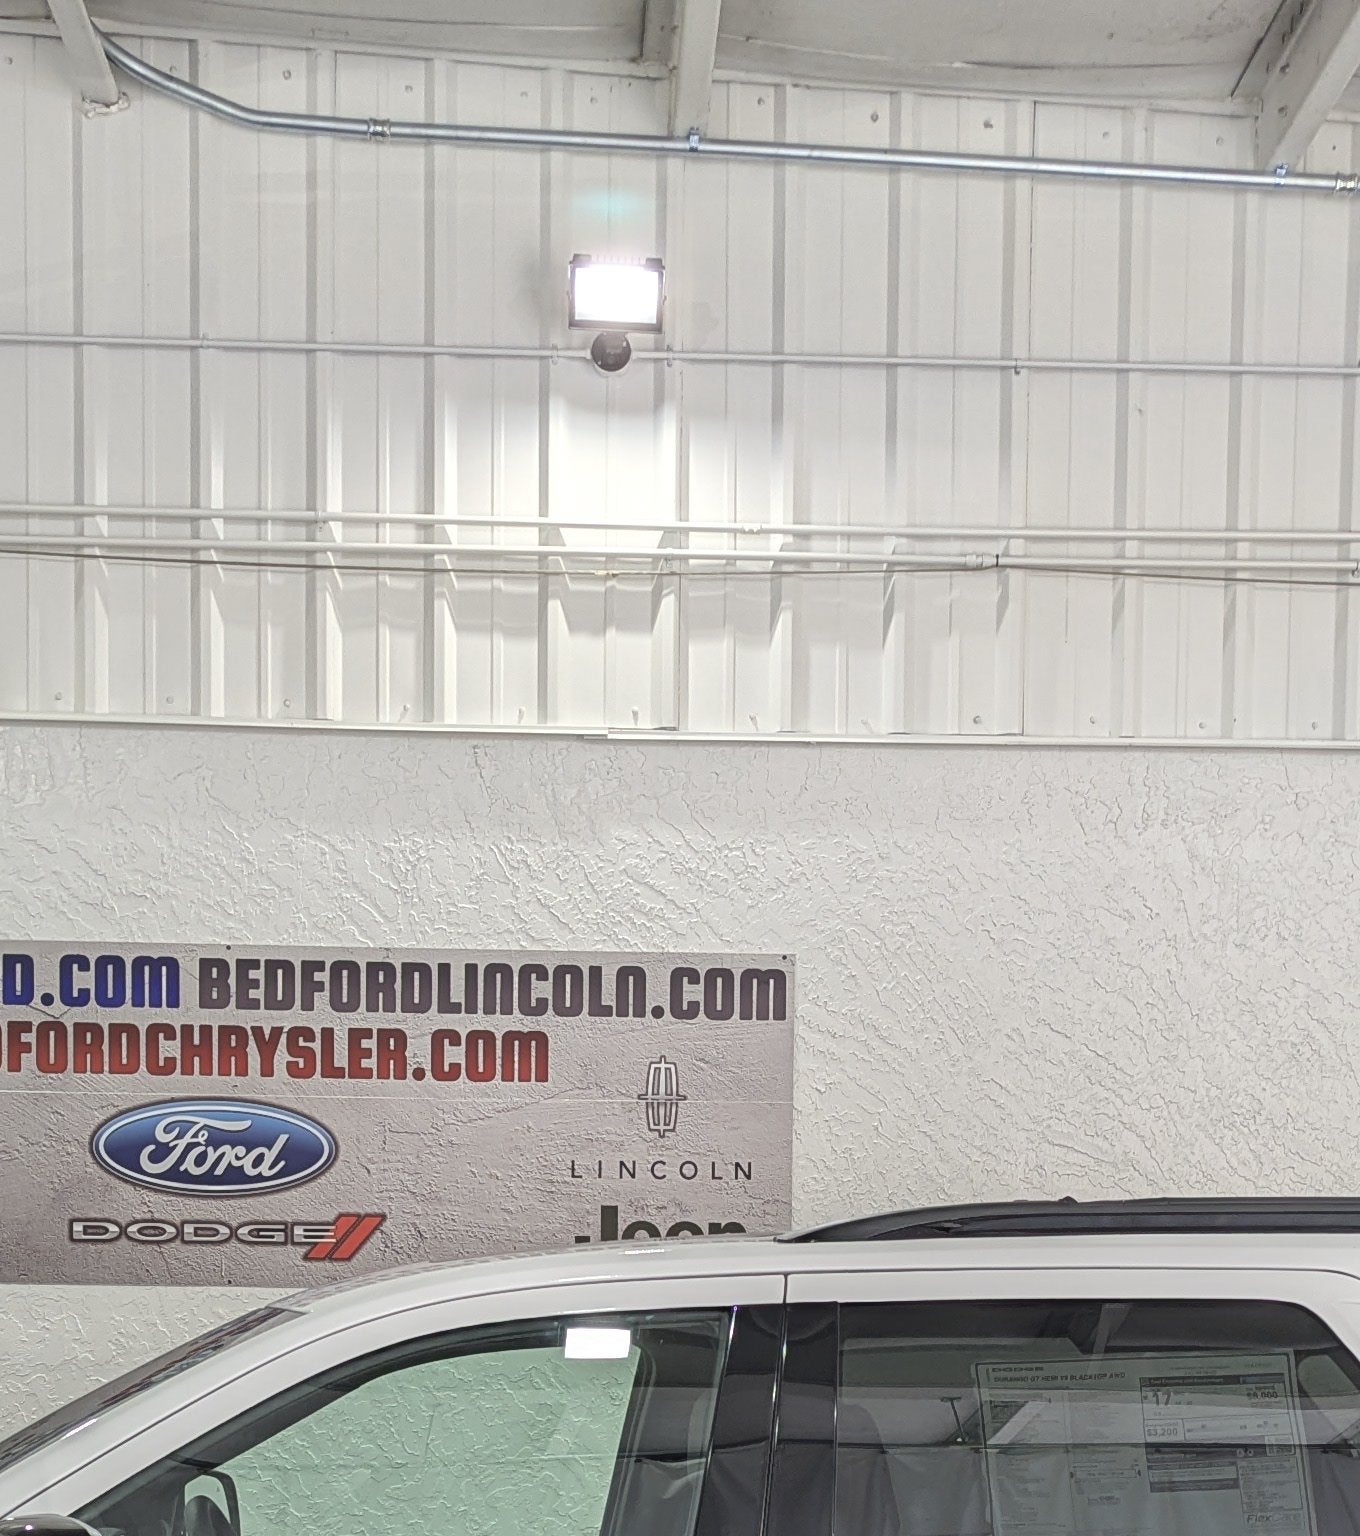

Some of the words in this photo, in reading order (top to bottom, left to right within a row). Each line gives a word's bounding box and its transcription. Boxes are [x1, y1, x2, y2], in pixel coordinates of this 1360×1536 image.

[198, 957, 788, 1022] BEDFORDLINCOLN.COM
[139, 1115, 290, 1178] Ford
[570, 1159, 753, 1181] LINCOLN
[70, 1219, 339, 1245] DODGE
